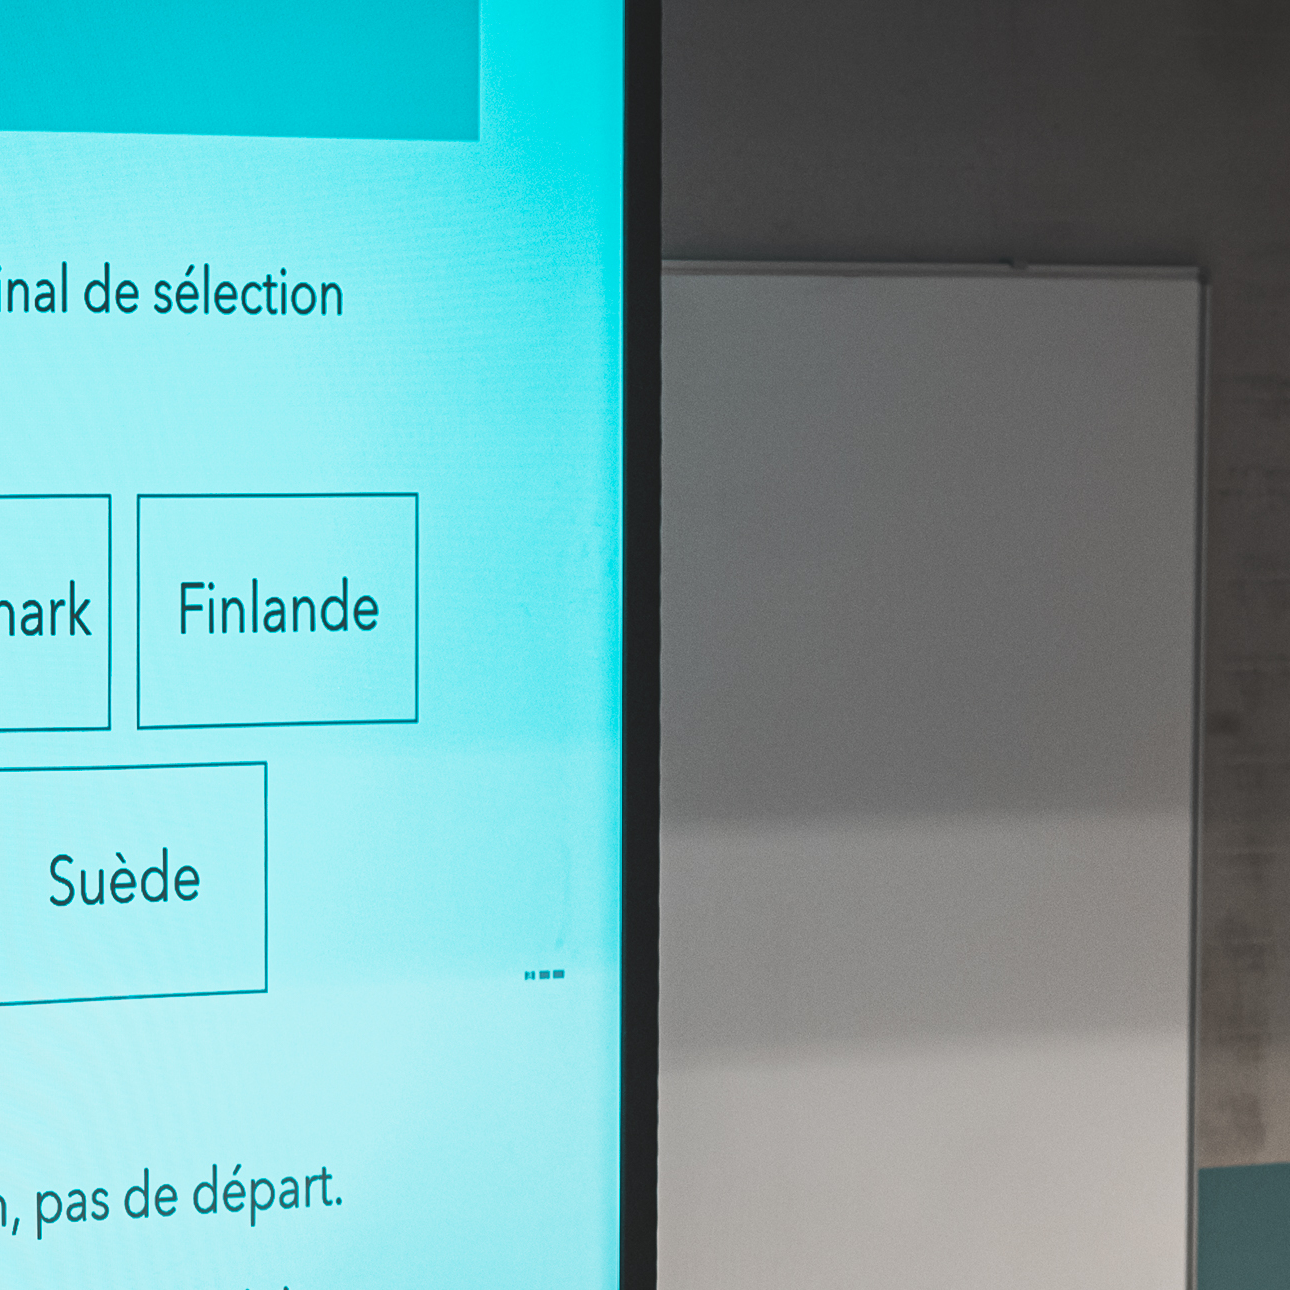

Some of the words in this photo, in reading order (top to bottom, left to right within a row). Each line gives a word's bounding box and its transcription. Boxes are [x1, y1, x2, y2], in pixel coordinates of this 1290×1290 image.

[84, 261, 139, 314] de
[153, 263, 342, 315] sélection
[180, 576, 379, 635] Finlande
[49, 847, 200, 907] Suède
[36, 1188, 110, 1240] pas
[124, 1167, 178, 1219] de
[193, 1163, 342, 1227] départ.
